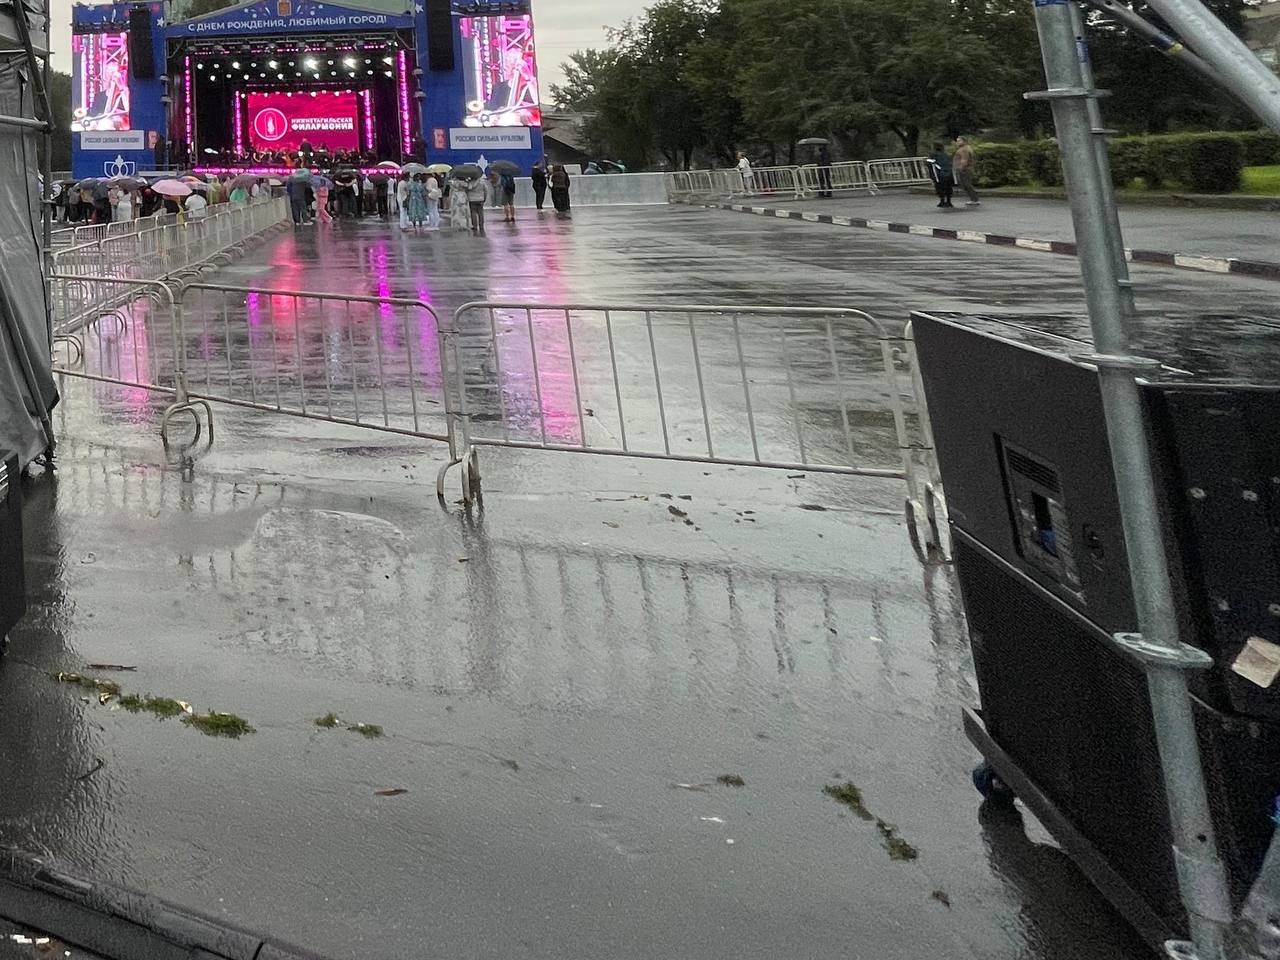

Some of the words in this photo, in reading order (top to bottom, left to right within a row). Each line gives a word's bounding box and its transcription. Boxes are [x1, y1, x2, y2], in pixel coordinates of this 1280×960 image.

[188, 23, 196, 32] С
[197, 22, 225, 32] ДНЕМ
[227, 19, 287, 30] РОЖДЕНИЯ,
[289, 15, 346, 27] ЛЮБИМЫЙ
[348, 15, 387, 25] ГОРОД!
[291, 123, 354, 131] ФИЛАРМОНИЯ
